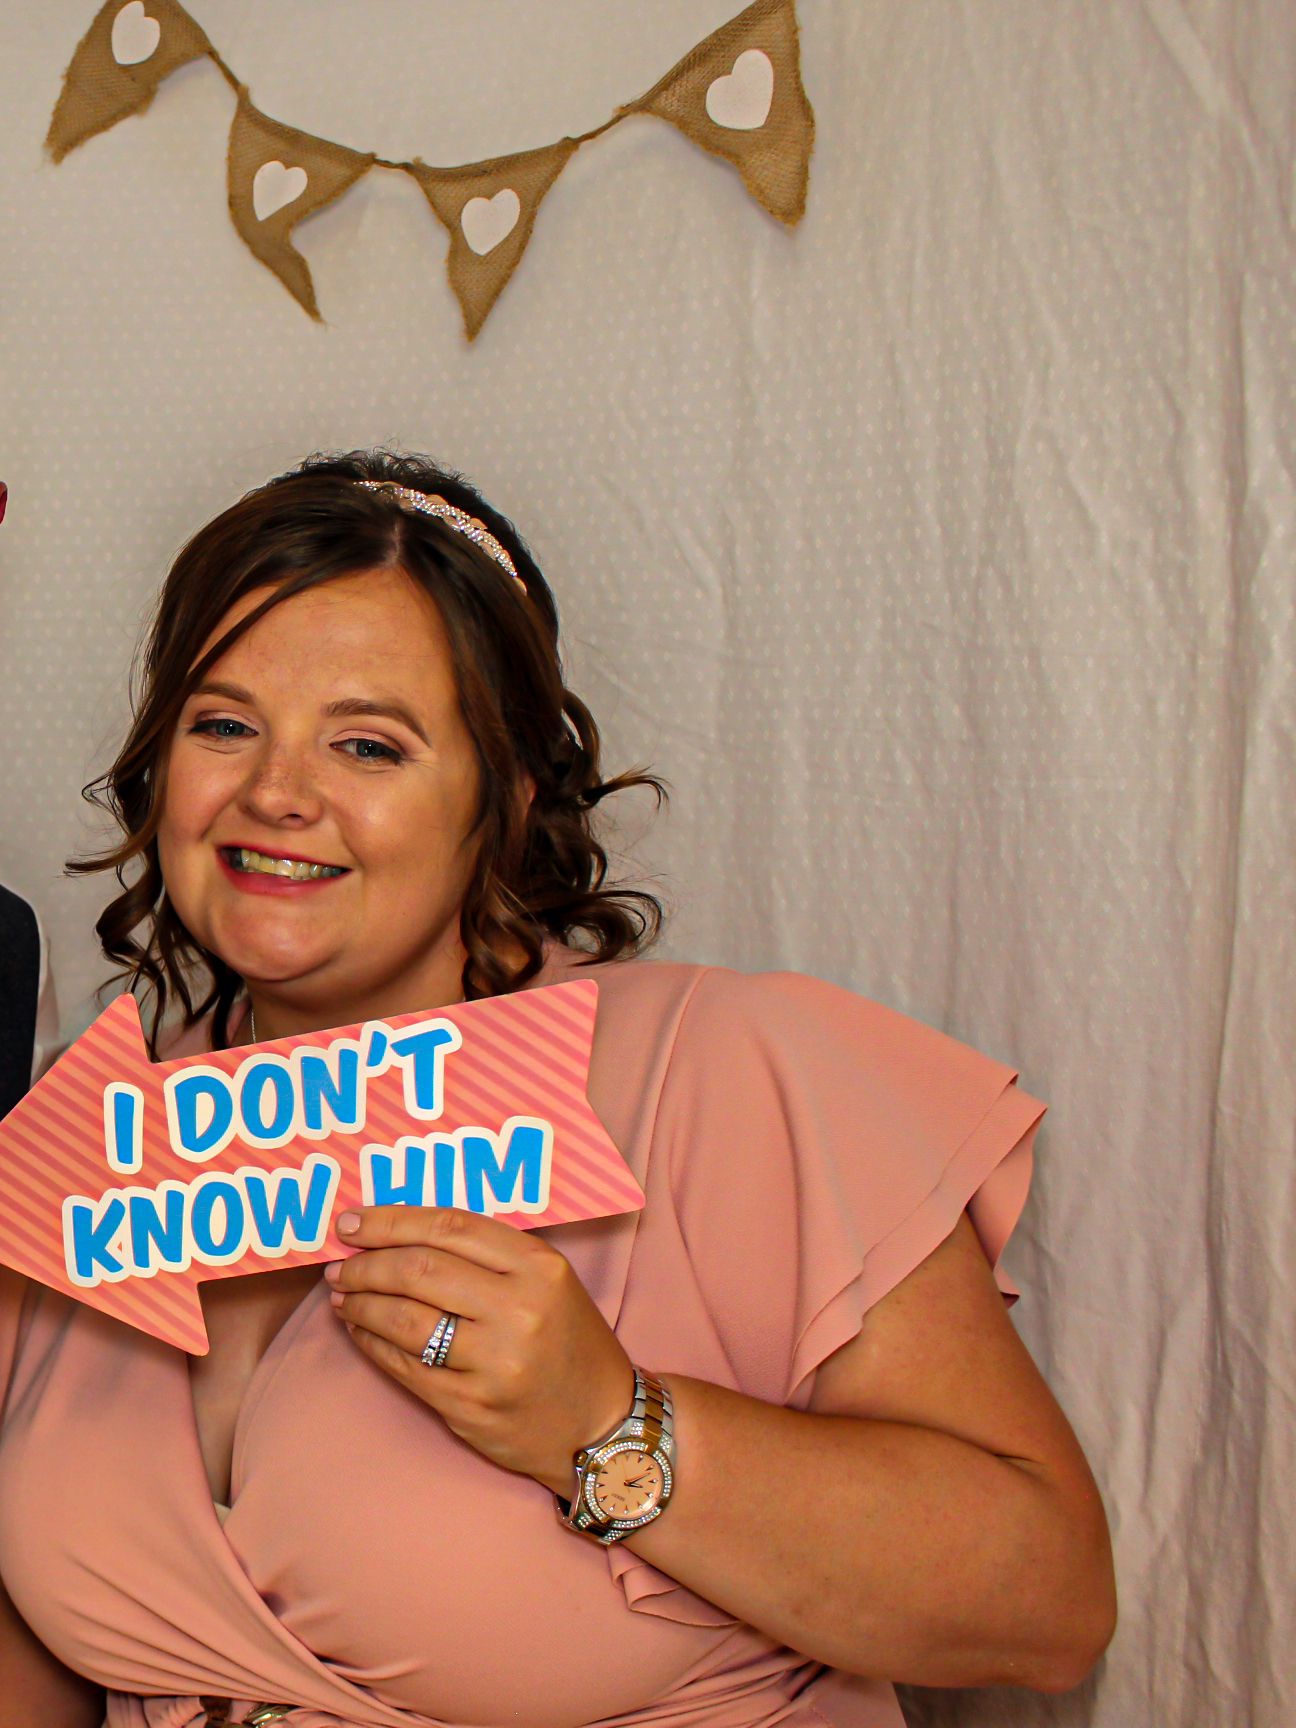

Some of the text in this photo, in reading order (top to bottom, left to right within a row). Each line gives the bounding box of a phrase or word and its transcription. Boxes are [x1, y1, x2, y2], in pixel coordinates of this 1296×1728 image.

[111, 1027, 455, 1168] I DON'T
[70, 1124, 546, 1280] KNOW HIM
